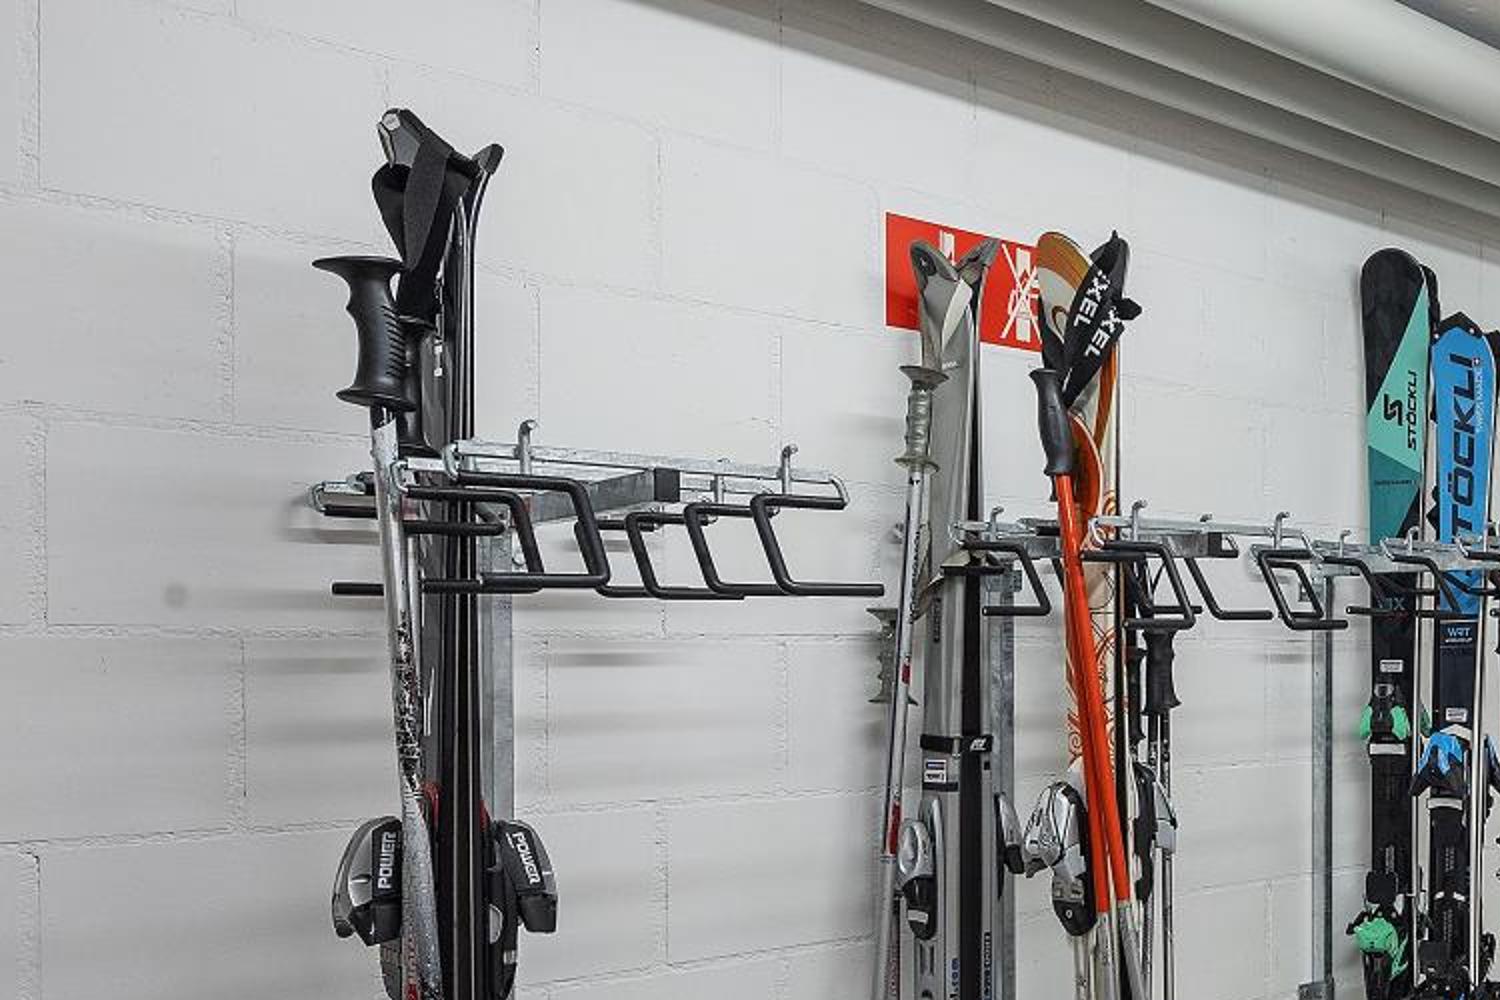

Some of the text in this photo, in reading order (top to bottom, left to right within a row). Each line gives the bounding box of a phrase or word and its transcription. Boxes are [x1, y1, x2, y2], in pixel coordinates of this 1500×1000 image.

[1074, 270, 1110, 327] XEL
[1085, 306, 1121, 357] XEL
[1405, 369, 1417, 451] STÖCKLI
[1447, 353, 1475, 545] TÖCKLI
[1447, 627, 1471, 637] WRT
[377, 831, 397, 890] POWER
[512, 831, 541, 886] POWER
